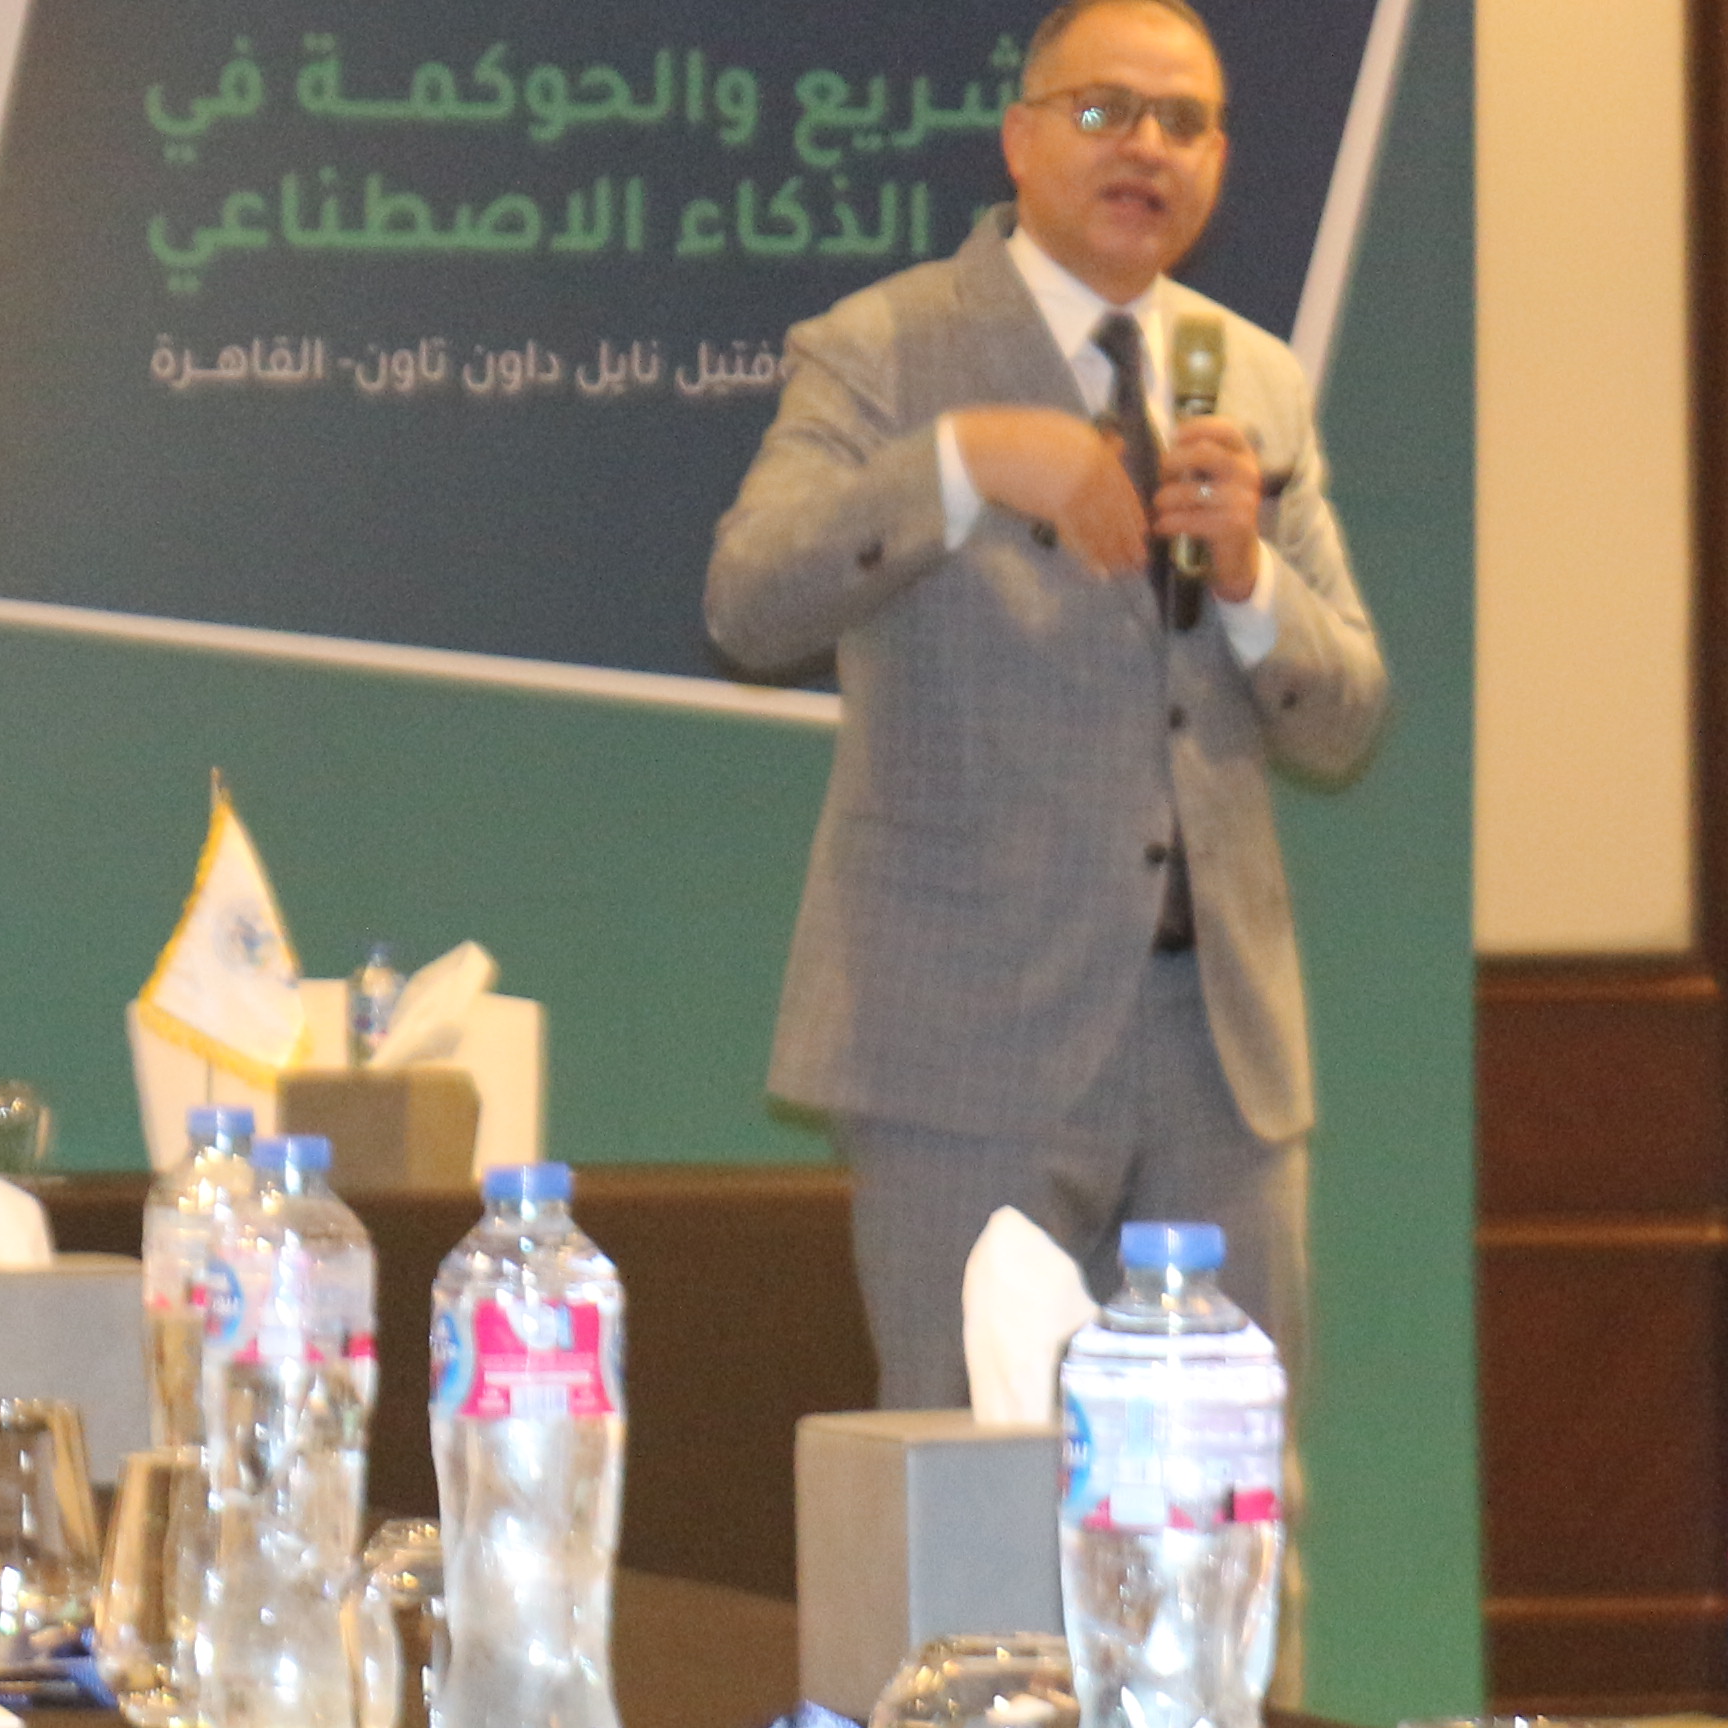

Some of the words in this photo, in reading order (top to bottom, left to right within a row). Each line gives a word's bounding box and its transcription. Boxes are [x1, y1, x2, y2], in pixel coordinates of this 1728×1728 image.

[144, 35, 264, 165] في
[792, 33, 1022, 167] شريع
[145, 165, 646, 294] الاصطناعي
[674, 178, 932, 258] الذكاء
[150, 332, 325, 390] القاهرة
[461, 338, 562, 395] داون
[574, 339, 662, 397] نايل
[674, 339, 790, 397] فتيل
